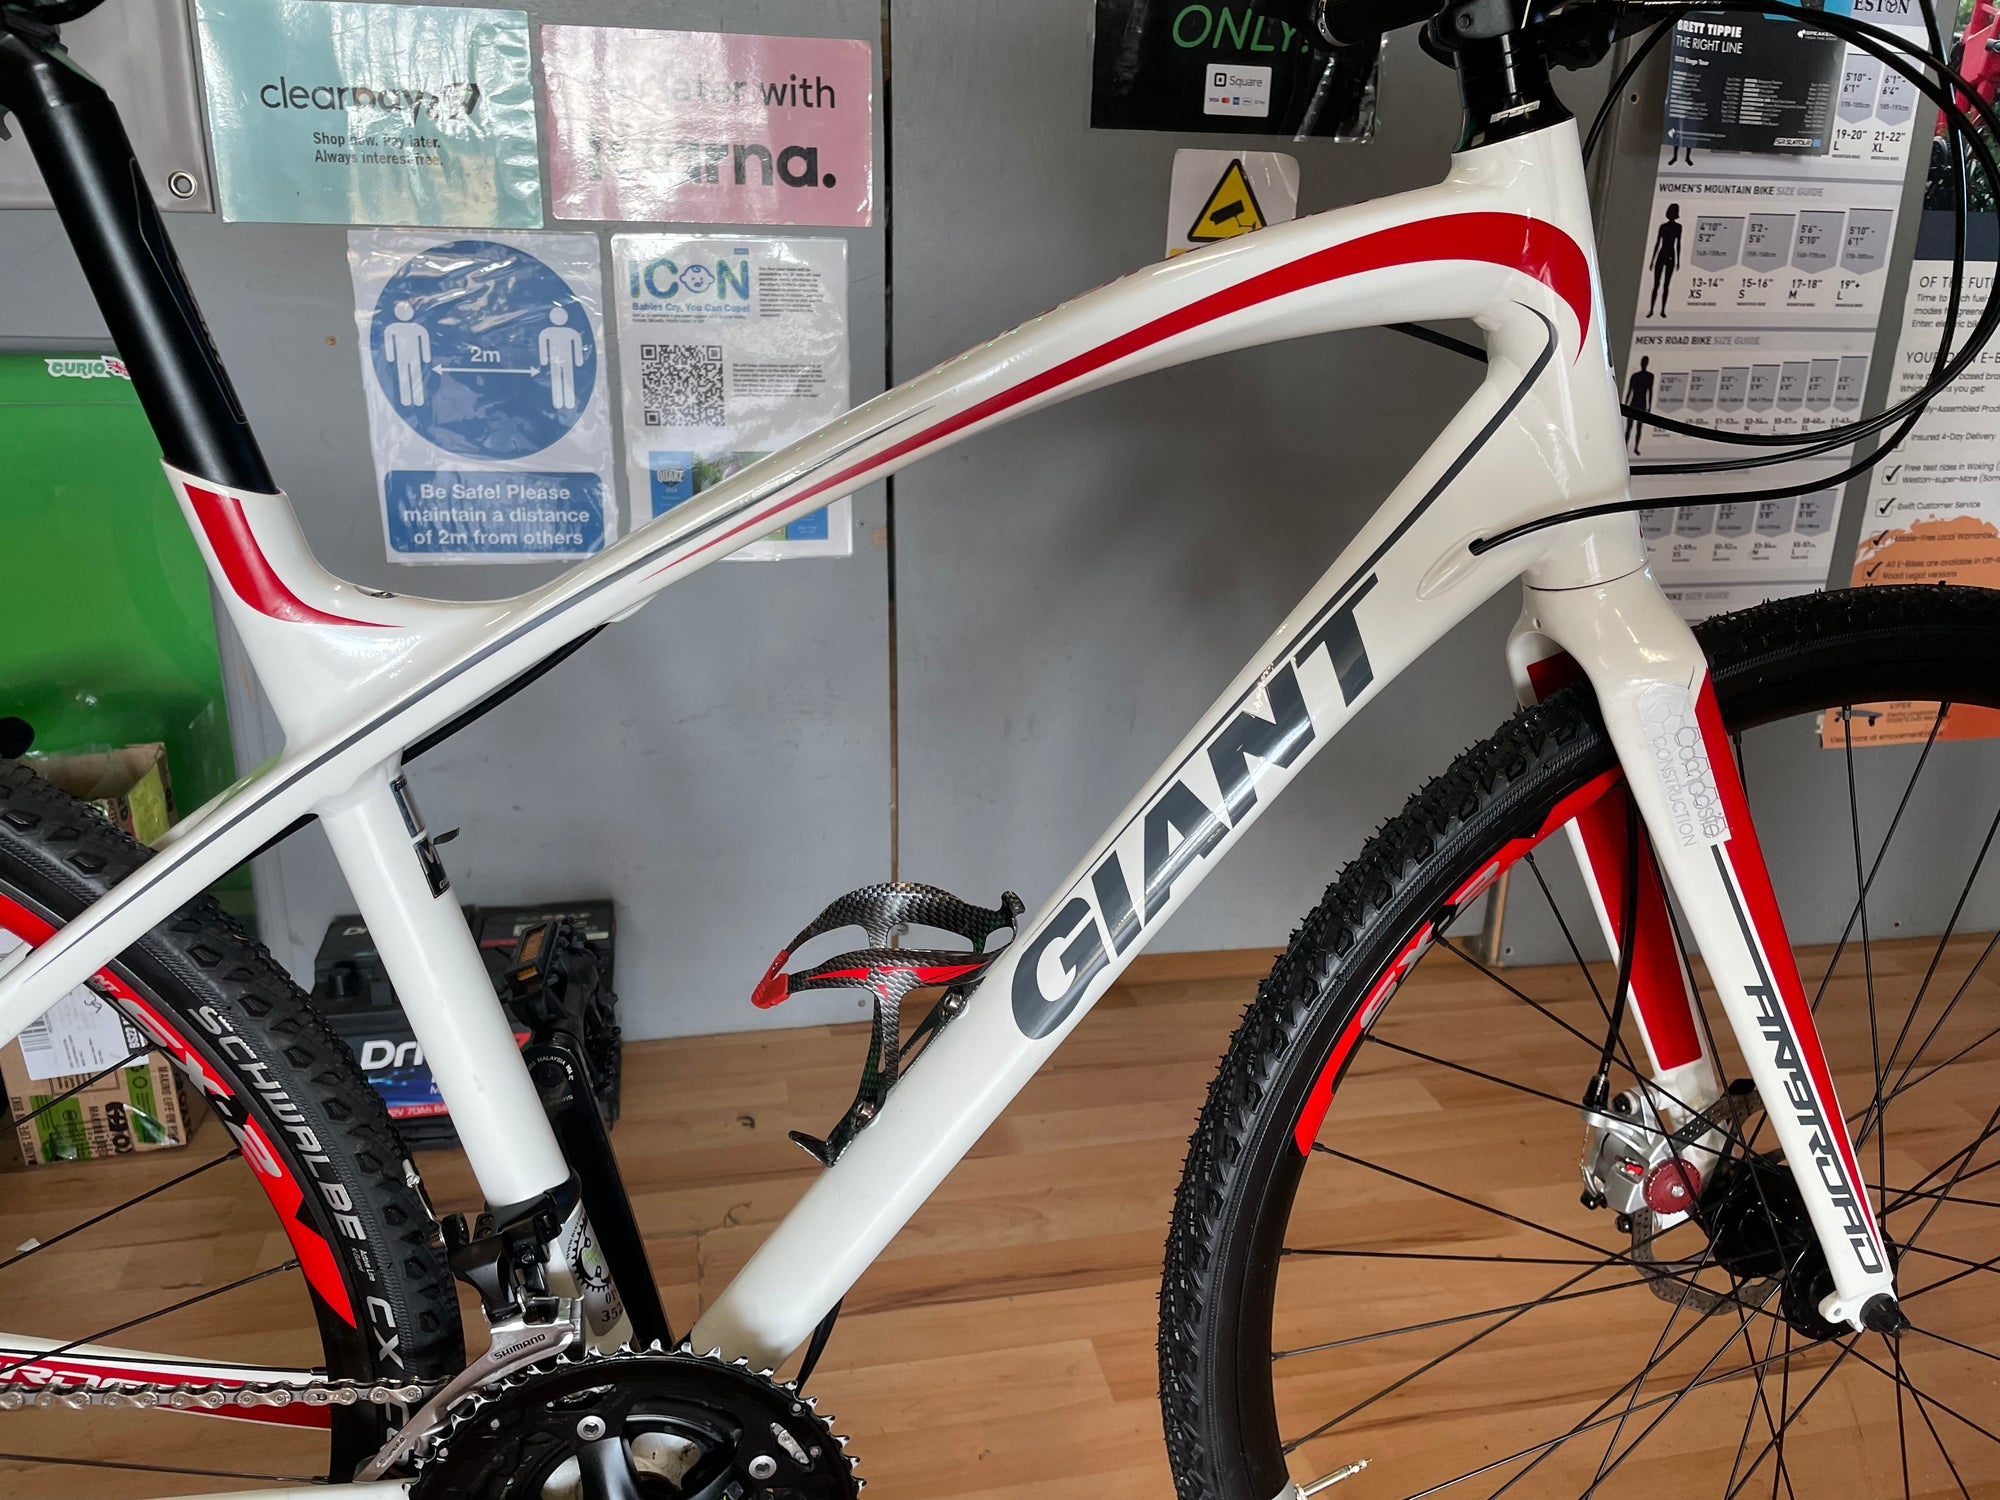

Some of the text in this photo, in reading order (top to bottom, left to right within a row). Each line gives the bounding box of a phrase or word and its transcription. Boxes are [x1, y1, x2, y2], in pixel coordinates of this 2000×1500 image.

[1677, 19, 1743, 39] BRETT TIPPIE
[1676, 34, 1743, 55] THE RIGHT LINE
[1229, 75, 1263, 88] Square
[760, 73, 836, 108] with
[313, 132, 345, 148] Shop
[349, 135, 379, 148] now.
[409, 135, 442, 149] later.
[1836, 129, 1867, 140] 19-20"
[1874, 131, 1906, 142] 21-22"
[1872, 143, 1884, 153] XL
[315, 150, 358, 166] Always
[1659, 183, 1824, 198] WOMEN'S MOUNTAIN BIKE SIZE GUIDE
[1692, 278, 1724, 288] 13-14"
[1742, 278, 1774, 288] 15-16"
[1792, 279, 1823, 289] 17-18"
[1920, 276, 1938, 288] OF
[1688, 290, 1702, 299] XS
[1738, 289, 1745, 300] S
[1788, 290, 1798, 300] M
[1837, 291, 1843, 301] L
[633, 303, 662, 312] Babies
[686, 303, 702, 313] You
[704, 304, 722, 313] Can
[1636, 336, 1760, 346] MEN'S ROAD BIKE SIZE GUIDE
[470, 347, 500, 363] 2m
[52, 362, 106, 375] CURIO
[656, 470, 685, 483] QUAKE
[420, 484, 570, 500] Be Safe! Please
[403, 507, 590, 523] maintain a distance
[413, 530, 583, 545] of 2m from others
[1652, 735, 1698, 847] CONSTRUCTION
[1011, 572, 1378, 1040] GIANT
[538, 1055, 566, 1067] MALAYSIA
[188, 1006, 367, 1241] SCHWALBE
[367, 1295, 404, 1370] CX
[493, 1332, 546, 1360] SHIMANO
